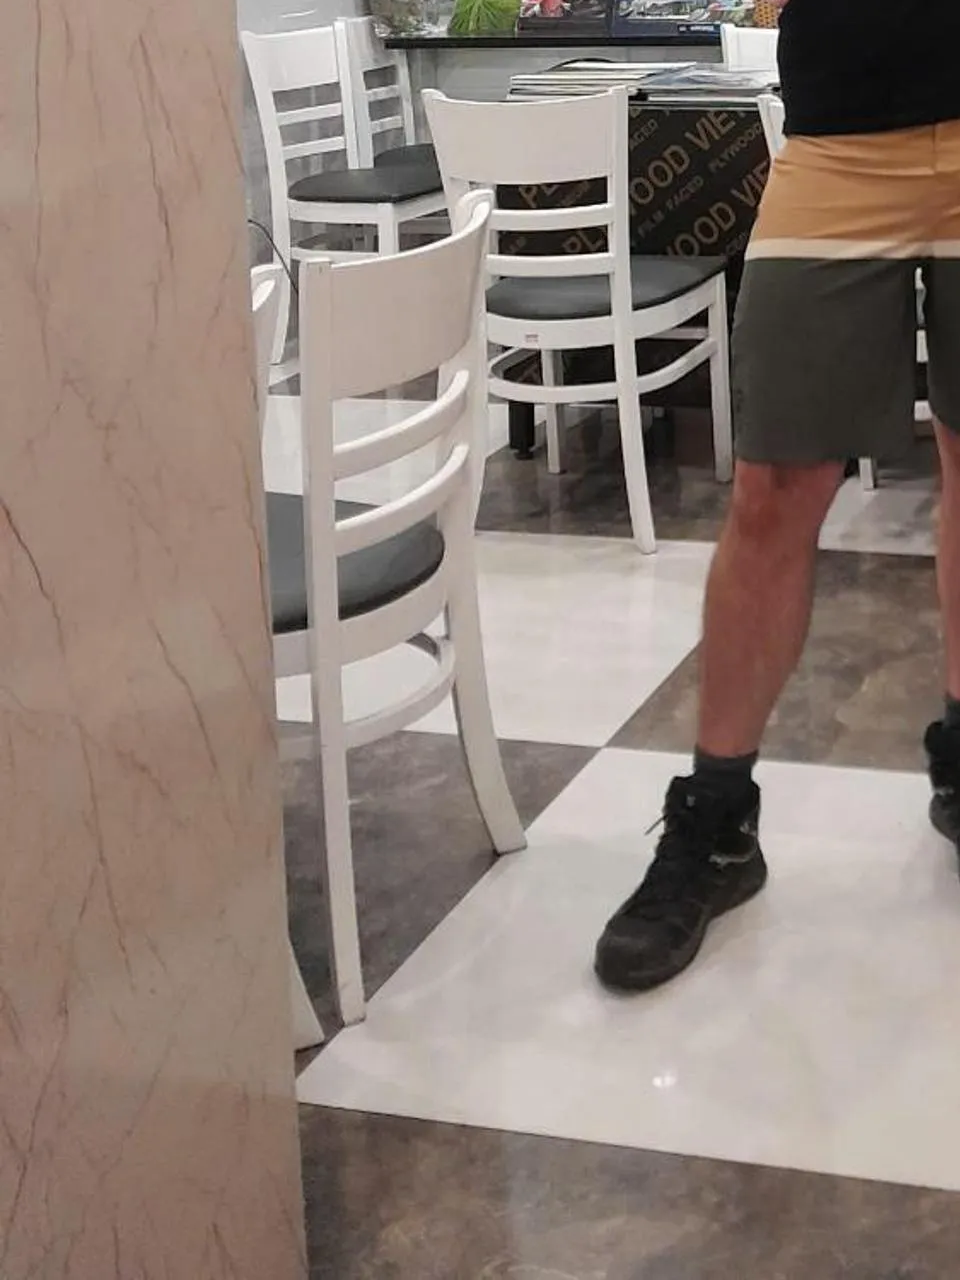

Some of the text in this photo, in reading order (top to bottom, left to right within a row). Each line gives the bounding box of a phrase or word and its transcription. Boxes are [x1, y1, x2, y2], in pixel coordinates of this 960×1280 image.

[628, 144, 691, 214] OOD
[684, 111, 745, 151] VIE
[667, 201, 736, 256] OOD
